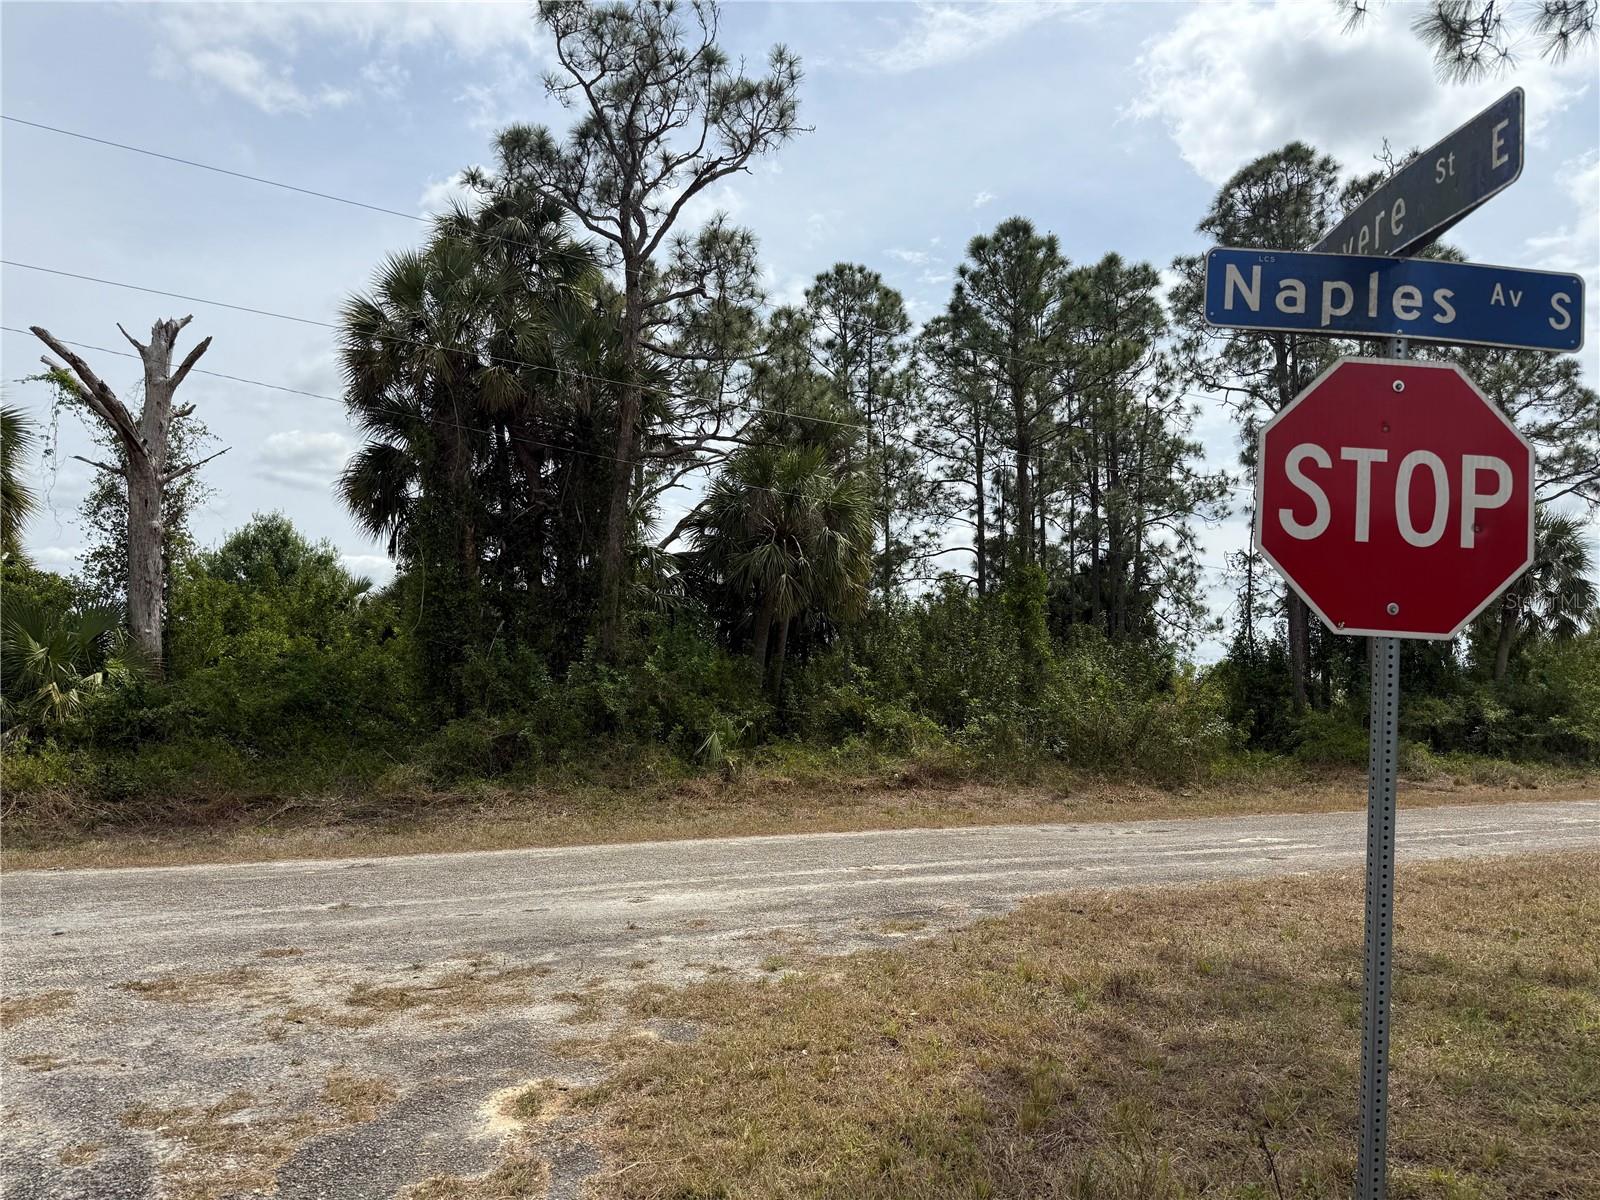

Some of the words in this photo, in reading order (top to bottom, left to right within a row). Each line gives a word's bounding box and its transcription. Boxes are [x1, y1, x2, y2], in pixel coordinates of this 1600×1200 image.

[1435, 152, 1455, 184] St
[1492, 118, 1509, 170] E
[1223, 263, 1457, 327] Naples
[1490, 283, 1523, 308] Av
[1548, 292, 1572, 330] S
[1278, 442, 1513, 549] STOP
